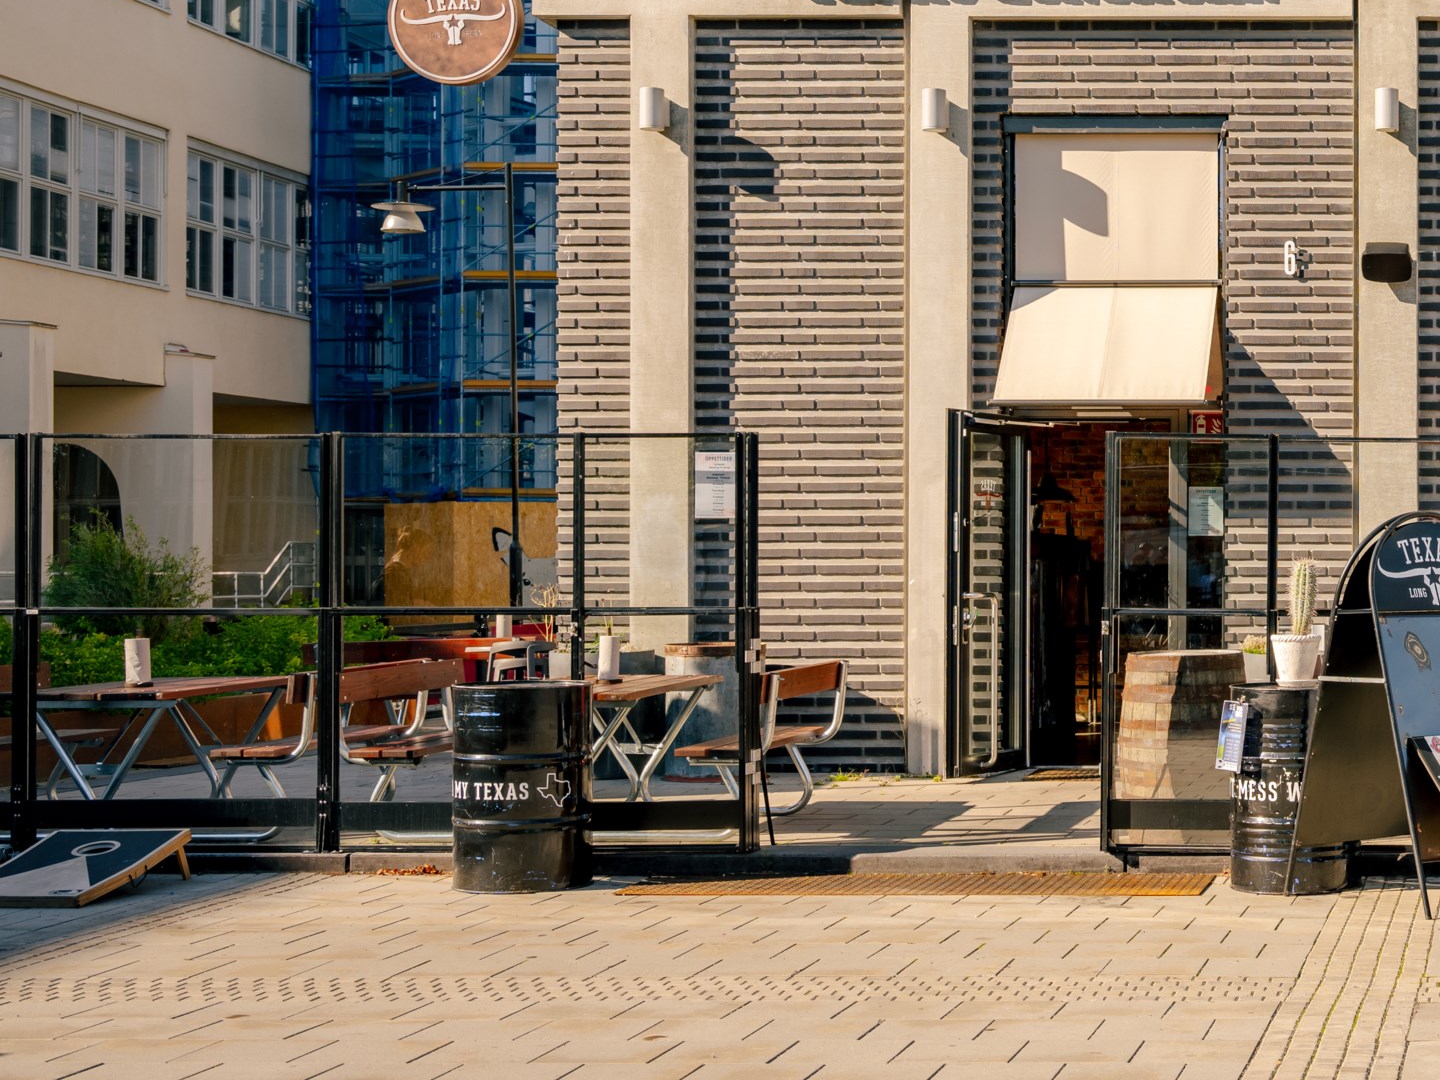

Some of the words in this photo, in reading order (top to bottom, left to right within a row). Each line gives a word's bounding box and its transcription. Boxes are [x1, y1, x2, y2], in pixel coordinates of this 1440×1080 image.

[1284, 240, 1296, 276] 6
[1408, 588, 1428, 598] LONG
[473, 781, 529, 801] TEXAS
[1238, 778, 1278, 802] MESS
